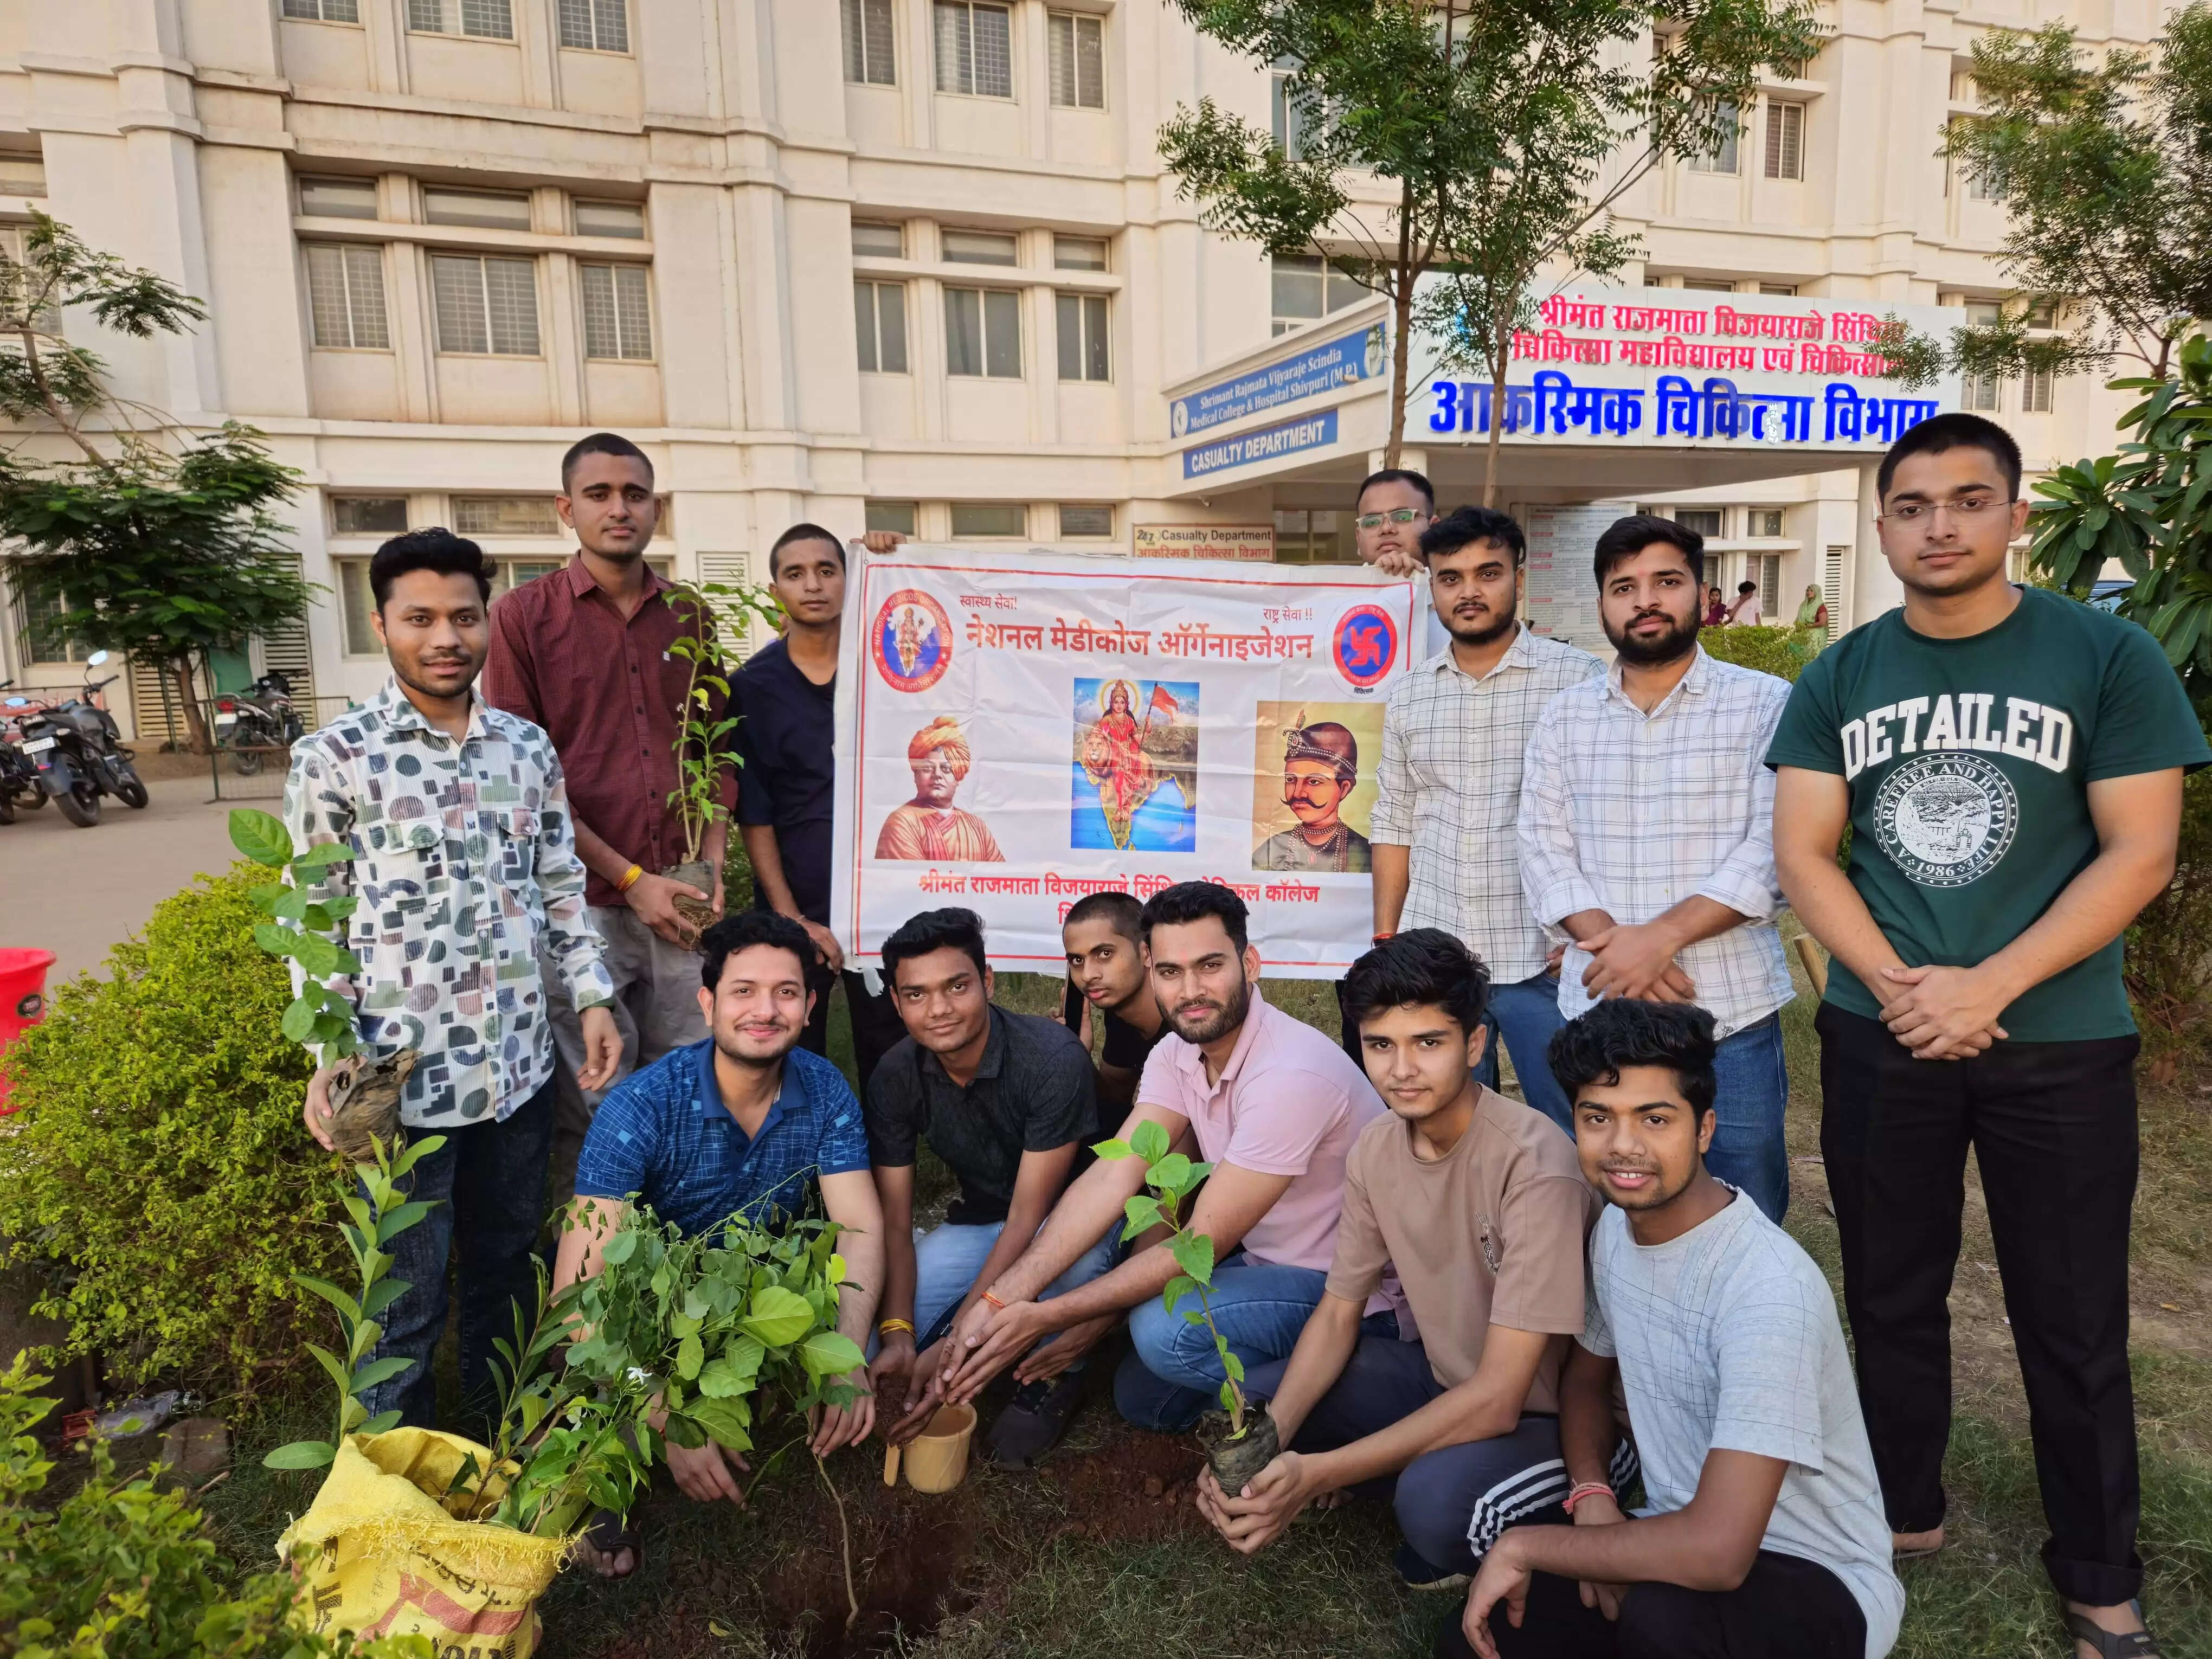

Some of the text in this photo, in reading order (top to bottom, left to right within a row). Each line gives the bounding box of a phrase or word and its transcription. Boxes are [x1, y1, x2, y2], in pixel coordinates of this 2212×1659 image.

[1540, 294, 1607, 329] श्रीमंत
[1612, 304, 1708, 335] राजमाता
[1714, 305, 1826, 340] विजयाराजे
[1510, 327, 1905, 378] चिकित्सा महाविद्यालय एवं चिकित्सा
[1191, 411, 1218, 430] Medical
[1219, 402, 1246, 419] College
[1246, 399, 1253, 411] &
[1255, 387, 1289, 409] Hospital
[1290, 375, 1328, 397] Shivpuri
[1200, 390, 1233, 409] Shrimant
[1235, 376, 1267, 398] Rajmata
[1308, 349, 1342, 372] Scindia
[1429, 370, 1645, 435] आकस्मिक
[1192, 420, 1324, 473] CASUALTY DEPARTMENT
[1137, 544, 1270, 558] आकस्मिक चिकित्सा विभाग
[1161, 530, 1207, 542] Casualty
[1211, 530, 1271, 542] Department
[874, 593, 949, 647] NATIONAL MEDICOS ORGANISATION
[960, 595, 992, 609] स्वास्थ्य
[1263, 608, 1279, 624] राष्ट्र
[1282, 606, 1302, 620] सेवा
[966, 613, 1314, 661] नेशनल मेडीकोज ऑर्गेनाइजेशन
[1841, 693, 2073, 782] DETAILED
[1939, 763, 1977, 779] AND
[1882, 765, 1935, 845] CAREFREE
[1977, 774, 2005, 834] HAPPY
[1915, 861, 1955, 877] 1986
[1964, 835, 1999, 868] LIFE
[919, 868, 967, 893] श्रीमंत
[970, 877, 1040, 895] राजमाता
[1265, 878, 1321, 903] कॉलेज
